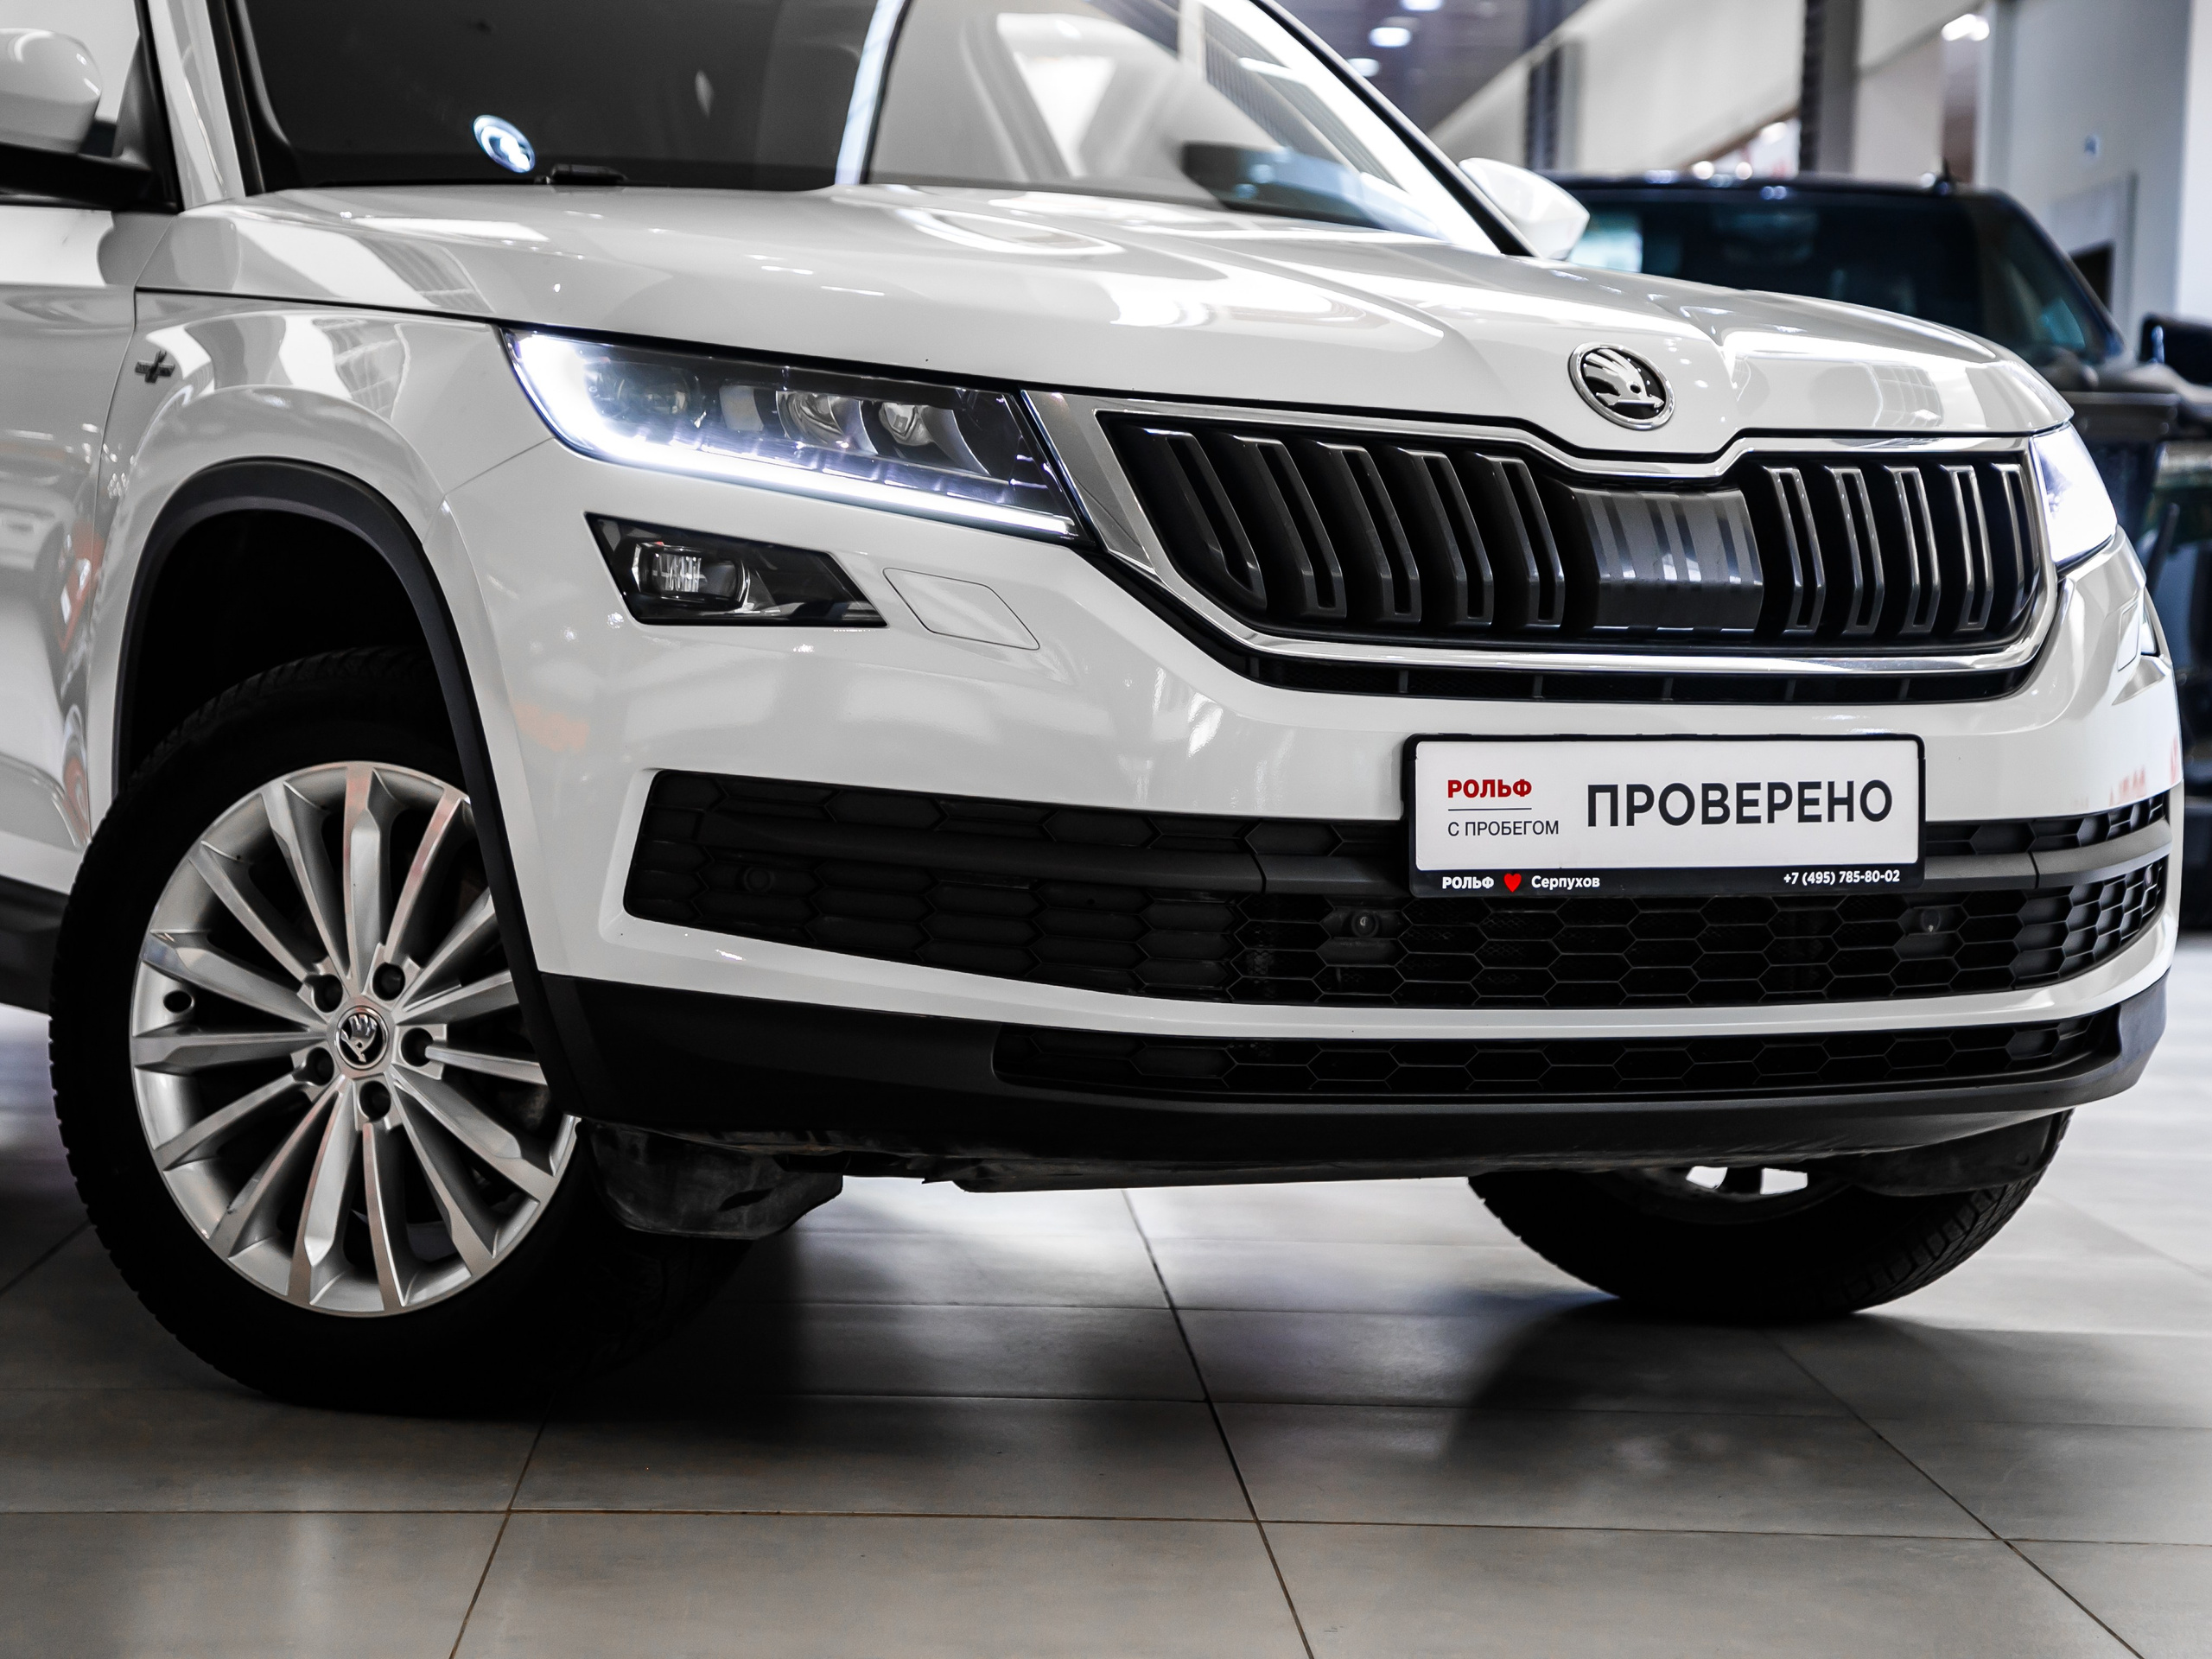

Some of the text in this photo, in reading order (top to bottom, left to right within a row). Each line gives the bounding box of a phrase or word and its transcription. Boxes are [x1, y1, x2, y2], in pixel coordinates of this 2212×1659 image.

[1447, 779, 1532, 798] РОЛЬФ
[1587, 779, 1892, 828] ПРОВЕРЕНО
[1447, 820, 1559, 837] С ПРОБЕГОМ
[1441, 874, 1601, 891] РОЛЬФ Серпухов
[1783, 869, 1900, 886] +7 (495) 785-80-02
